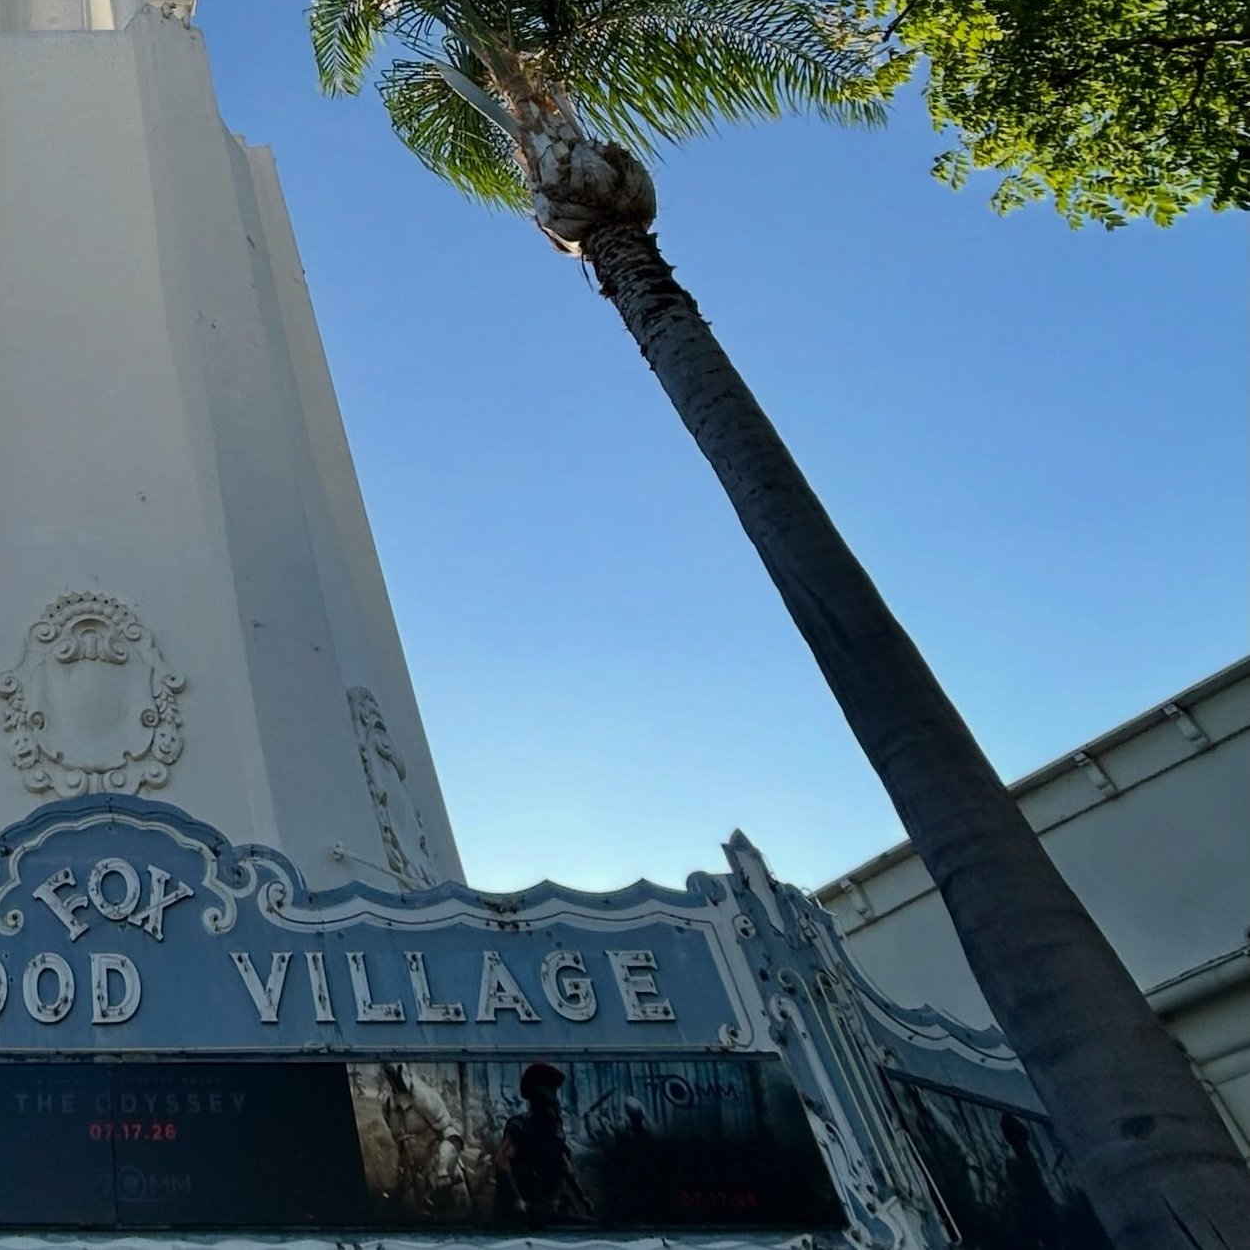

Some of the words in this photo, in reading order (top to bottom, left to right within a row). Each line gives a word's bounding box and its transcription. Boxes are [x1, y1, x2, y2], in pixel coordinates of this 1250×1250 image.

[32, 857, 195, 942] FOX
[229, 950, 676, 1023] VILLAGE
[13, 1093, 79, 1114] THE
[94, 1093, 247, 1114] ODYSSEY
[89, 1123, 176, 1141] 07.17.26
